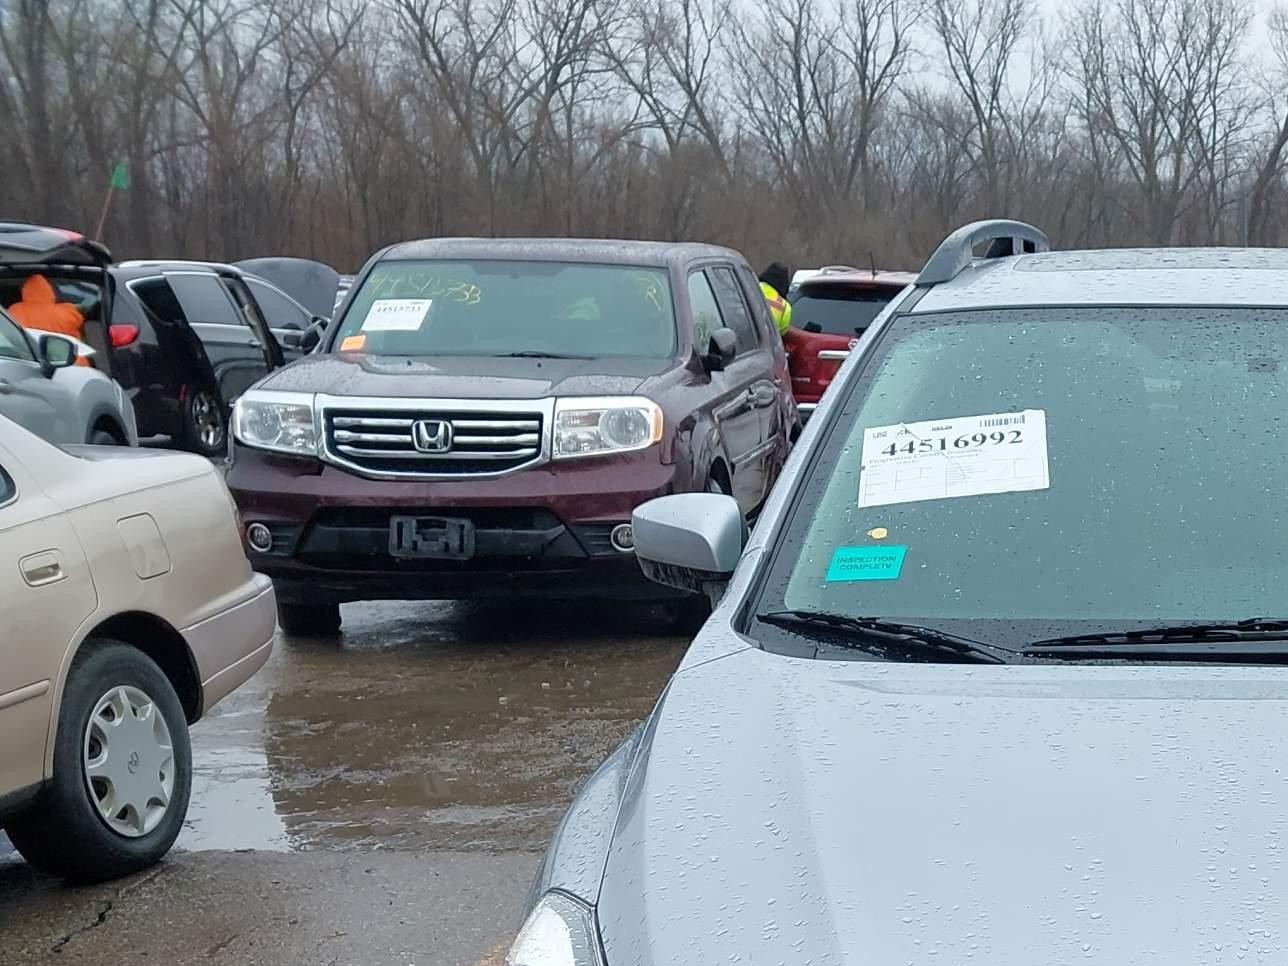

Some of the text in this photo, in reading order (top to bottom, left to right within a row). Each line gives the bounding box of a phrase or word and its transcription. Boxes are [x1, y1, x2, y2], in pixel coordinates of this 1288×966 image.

[880, 430, 1024, 457] 44516992
[837, 555, 897, 564] INSPECTION
[839, 563, 893, 571] COMPLETE
